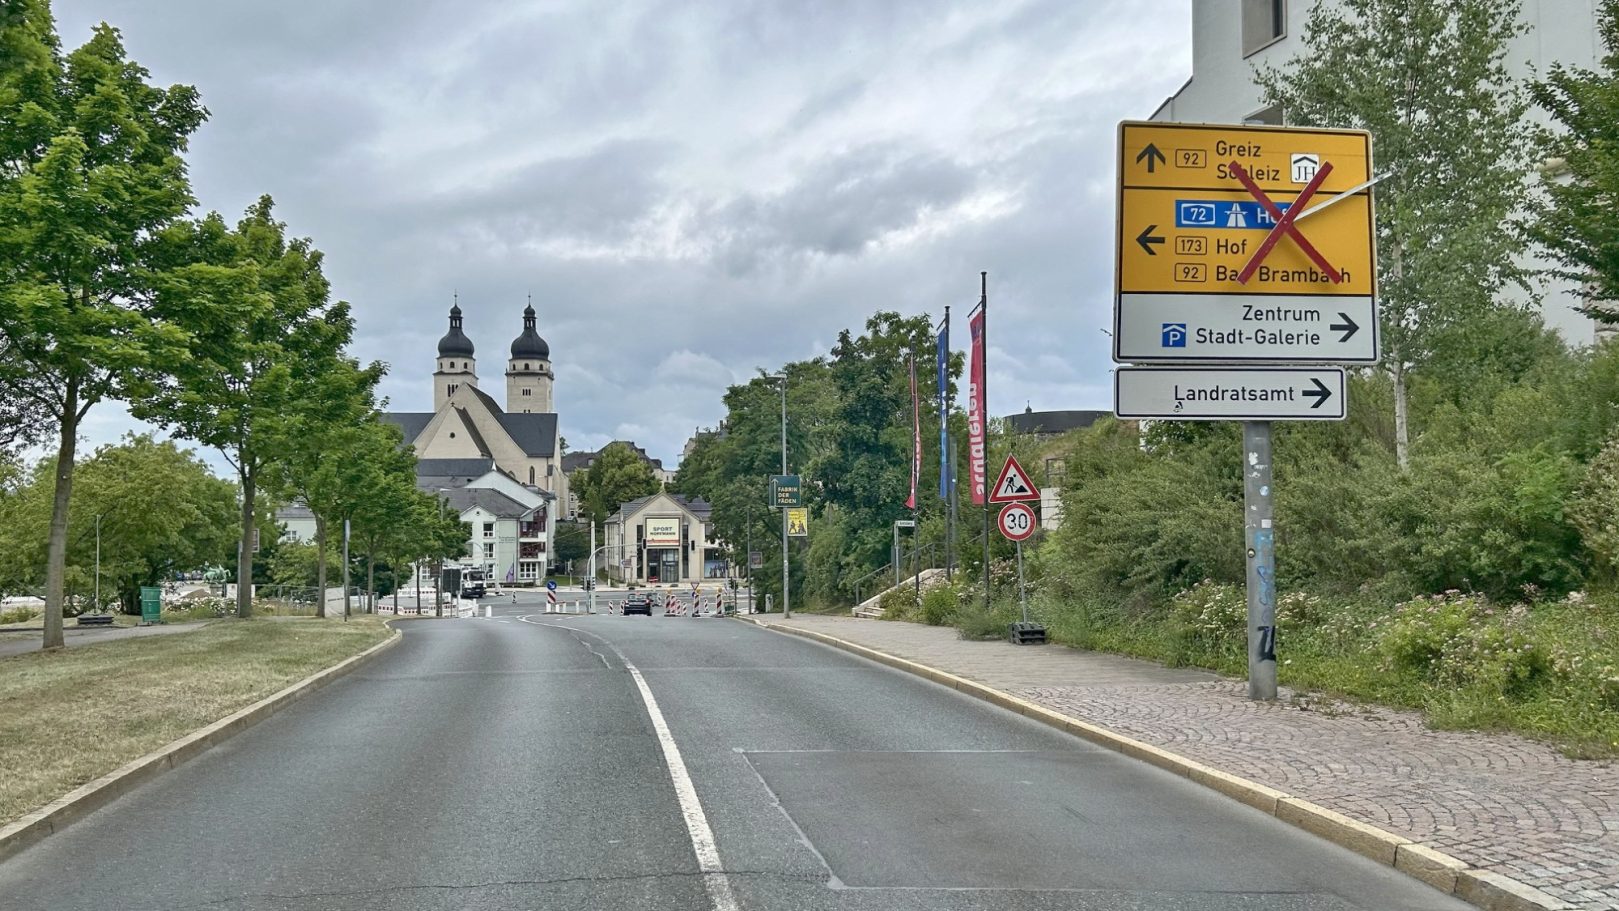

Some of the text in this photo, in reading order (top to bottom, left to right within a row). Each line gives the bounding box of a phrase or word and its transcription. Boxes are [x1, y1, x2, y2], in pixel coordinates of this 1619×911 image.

[1216, 140, 1261, 158] Greiz
[1183, 152, 1199, 165] 92
[1294, 165, 1316, 181] JH
[1190, 207, 1207, 221] 72
[1180, 238, 1248, 255] 173 Hof
[1183, 265, 1351, 283] 92 Ba Brambah
[1242, 304, 1321, 322] Zentrum
[1169, 328, 1321, 346] P Stadt-Galerie
[1174, 384, 1295, 402] Landratsamt
[1006, 513, 1028, 530] 30
